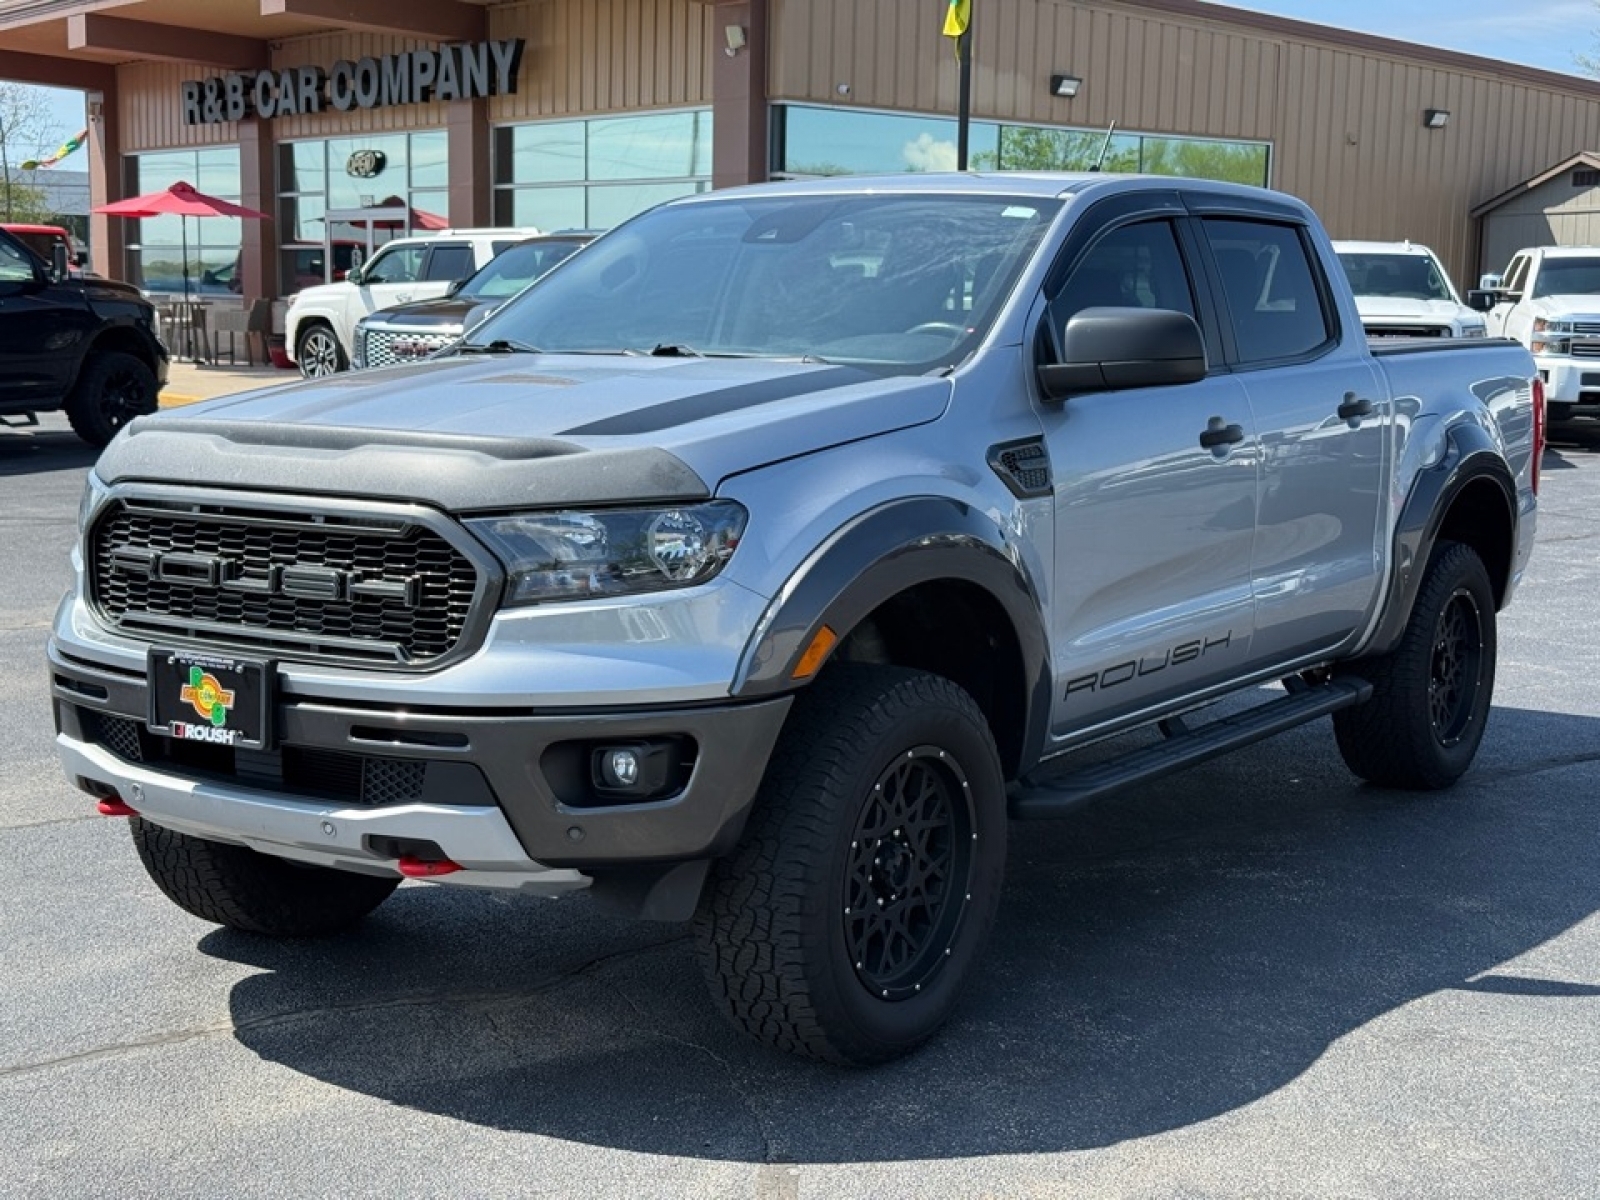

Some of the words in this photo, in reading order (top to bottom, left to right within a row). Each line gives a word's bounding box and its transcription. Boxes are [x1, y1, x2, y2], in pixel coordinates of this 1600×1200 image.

[182, 73, 248, 125] R&B
[256, 66, 324, 119] CAR
[330, 39, 525, 111] COMPANY
[1063, 629, 1232, 701] ROUSH
[185, 725, 234, 744] ROUSH
